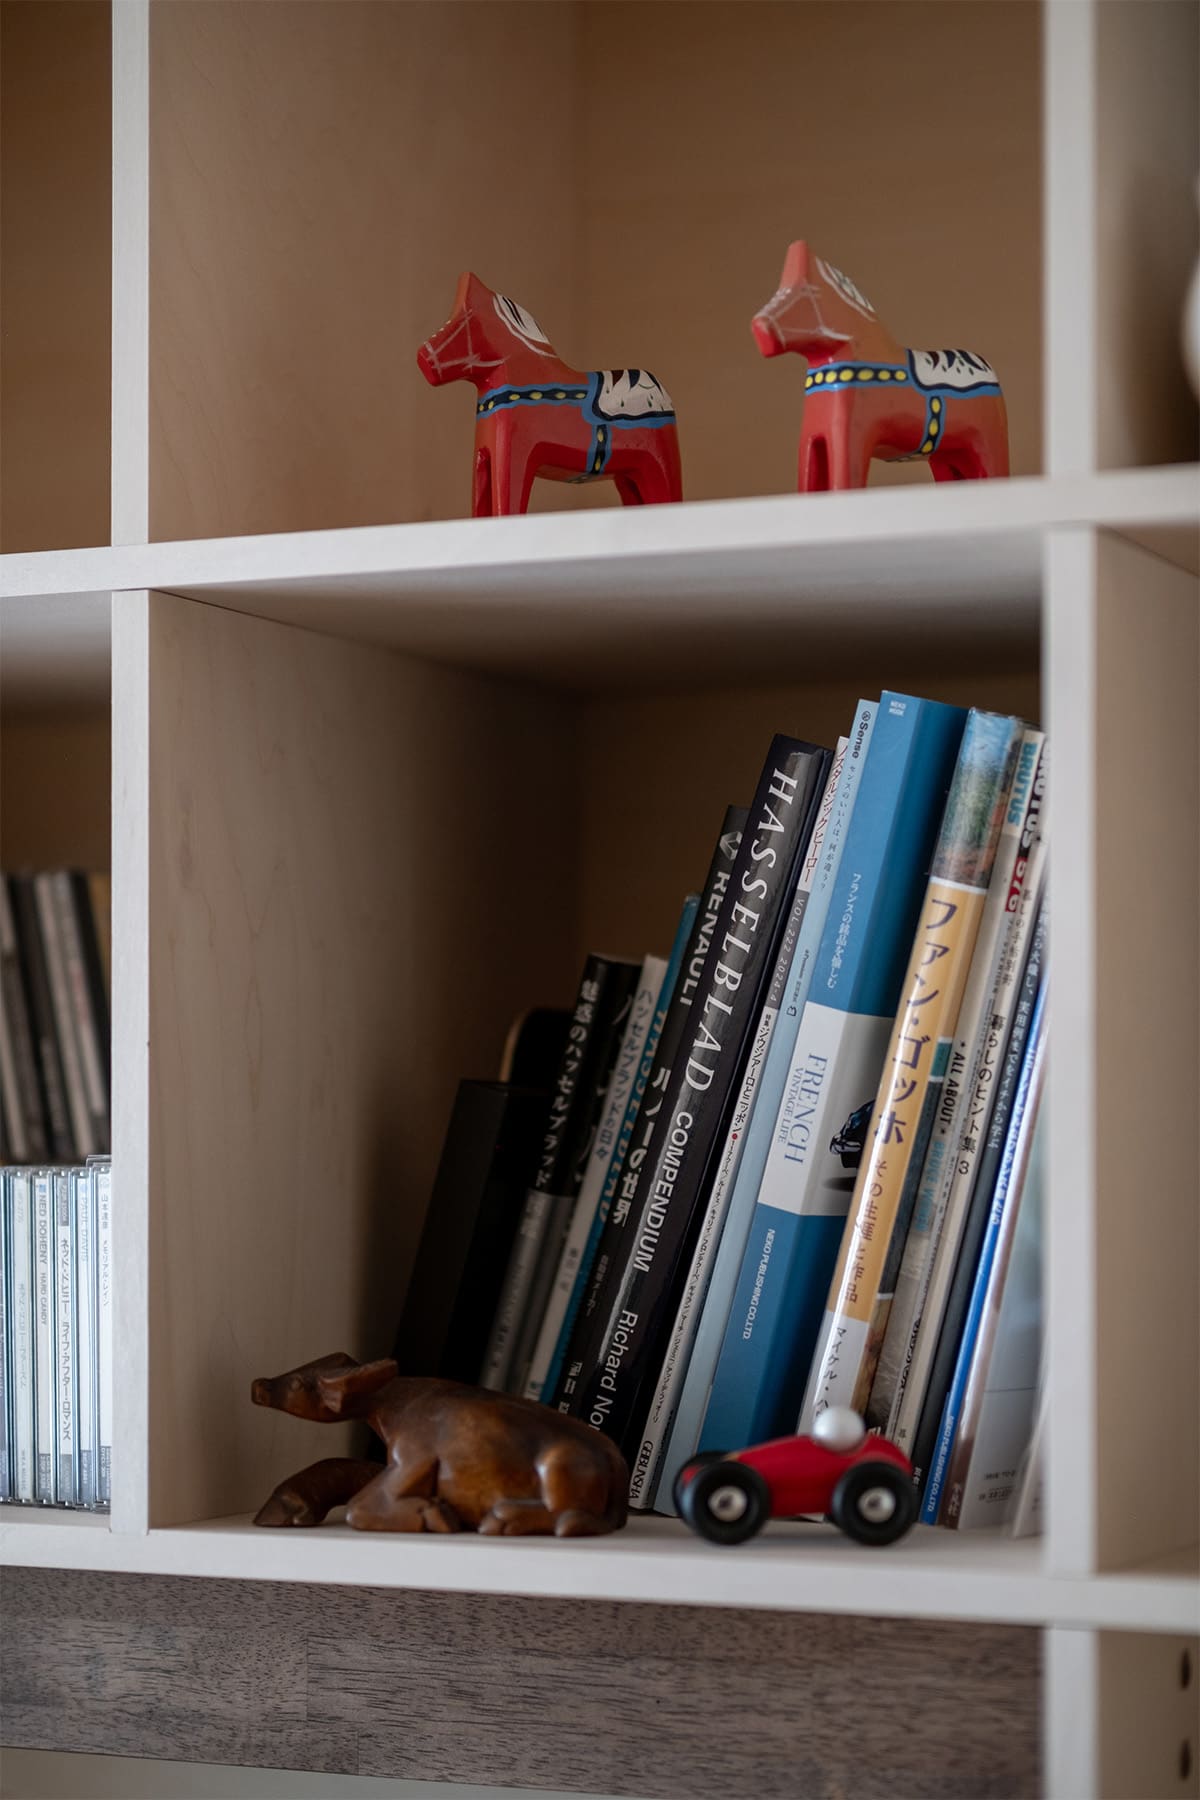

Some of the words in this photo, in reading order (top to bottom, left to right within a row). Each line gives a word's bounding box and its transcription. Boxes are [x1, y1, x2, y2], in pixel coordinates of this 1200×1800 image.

[852, 721, 869, 759] Sense
[1007, 742, 1038, 826] BRUTUS
[805, 746, 848, 883] ノスタルジックヒーロー
[685, 767, 798, 1092] HASSELBLAD
[784, 898, 806, 953] VOL.222
[873, 898, 957, 1144] ファン・ゴッホ
[596, 990, 653, 1161] ハッセルブラッドの日々
[950, 1052, 966, 1075] ALL
[784, 1067, 804, 1118] VINTAGE
[784, 1054, 828, 1164] FRENCH
[940, 1079, 960, 1125] ABOUT
[778, 1119, 792, 1144] LIFE
[39, 1194, 47, 1217] NED
[80, 1197, 88, 1223] PAUL
[633, 1111, 693, 1273] COMPENDIUM
[39, 1220, 48, 1265] DOHENY
[40, 1297, 48, 1326] CANDY
[599, 1309, 638, 1392] Richard
[589, 1394, 615, 1431] No
[629, 1439, 654, 1500] GEIBUNSHA
